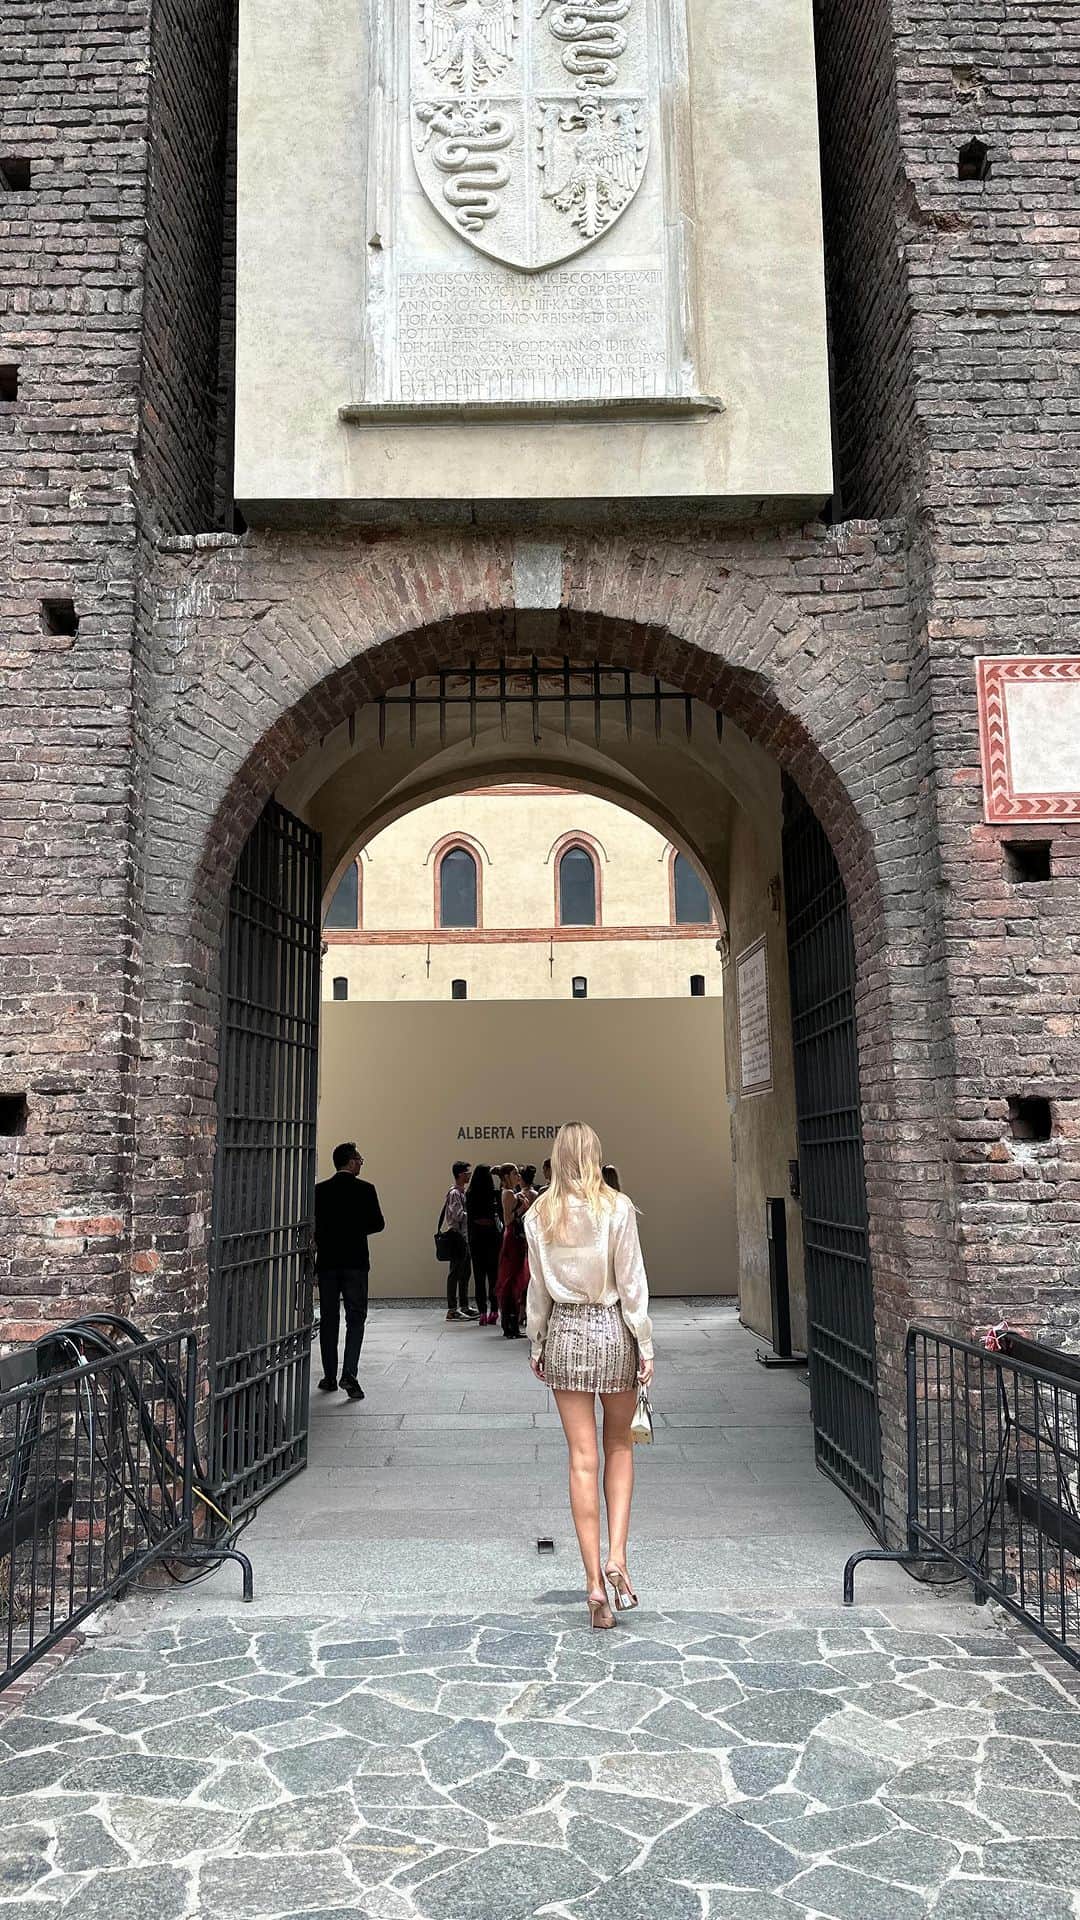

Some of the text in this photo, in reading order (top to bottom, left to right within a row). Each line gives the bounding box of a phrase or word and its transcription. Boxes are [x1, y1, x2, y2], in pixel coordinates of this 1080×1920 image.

[399, 272, 481, 285] FRANCISCVS
[399, 284, 637, 297] ET ANIMO INVICTVS ET CORPORE
[399, 300, 442, 312] ANNO
[399, 313, 438, 326] HORA
[530, 312, 568, 324] VRBIS
[399, 327, 487, 339] POTITVS EST
[457, 1126, 515, 1140] ALBERTA
